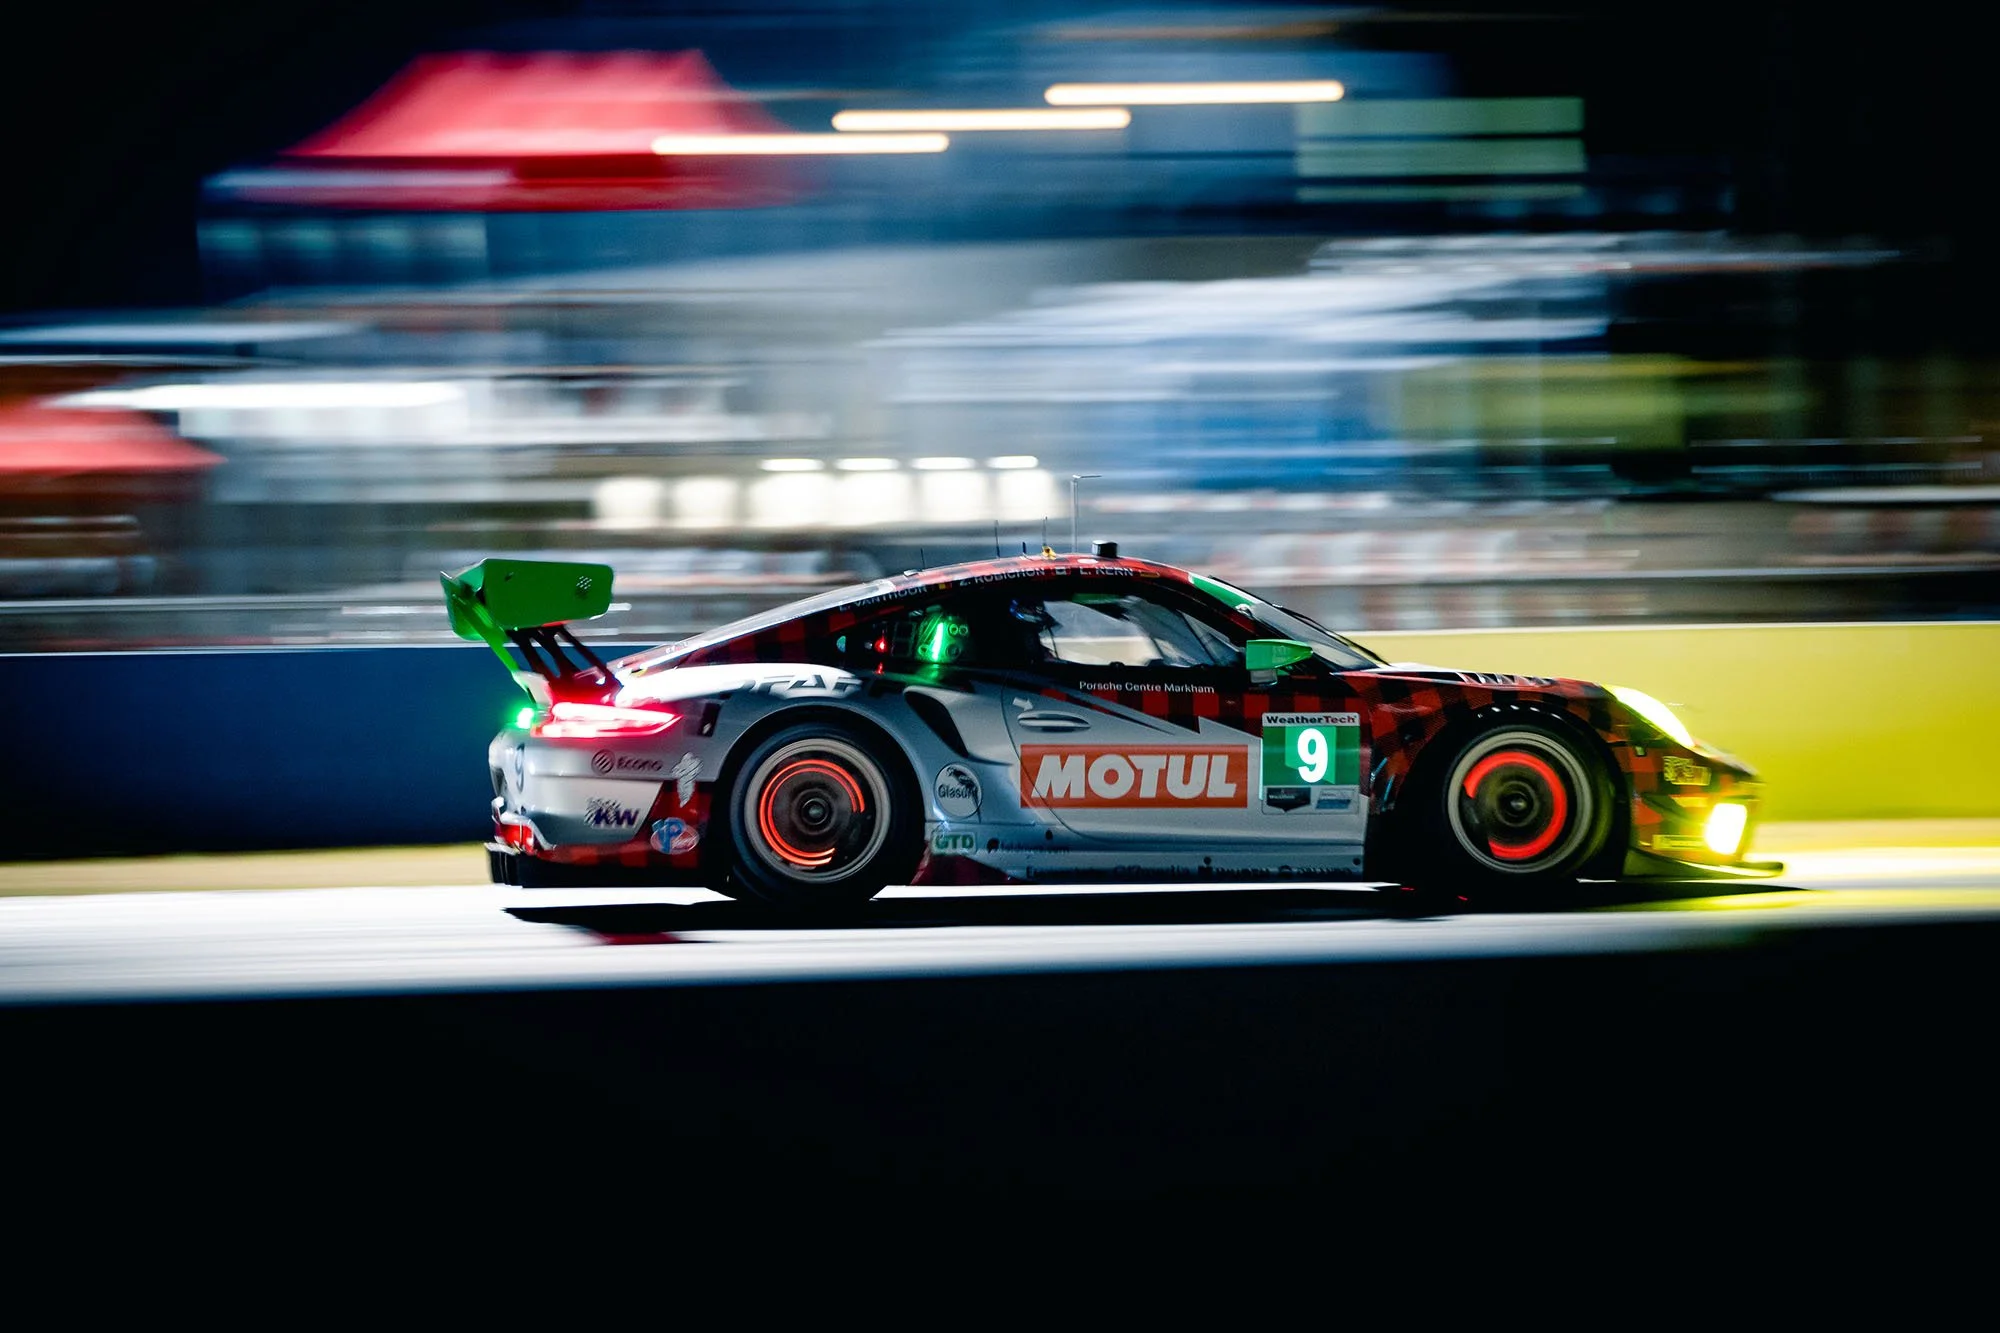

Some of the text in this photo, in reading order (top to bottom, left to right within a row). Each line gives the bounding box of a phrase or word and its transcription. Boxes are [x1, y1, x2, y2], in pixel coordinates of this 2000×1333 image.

[1079, 681, 1216, 694] Porsche Centre Markham
[1266, 715, 1357, 724] WeatherTech
[1297, 727, 1329, 783] 9
[1031, 753, 1237, 799] MOTUL
[936, 834, 974, 849] GTD
